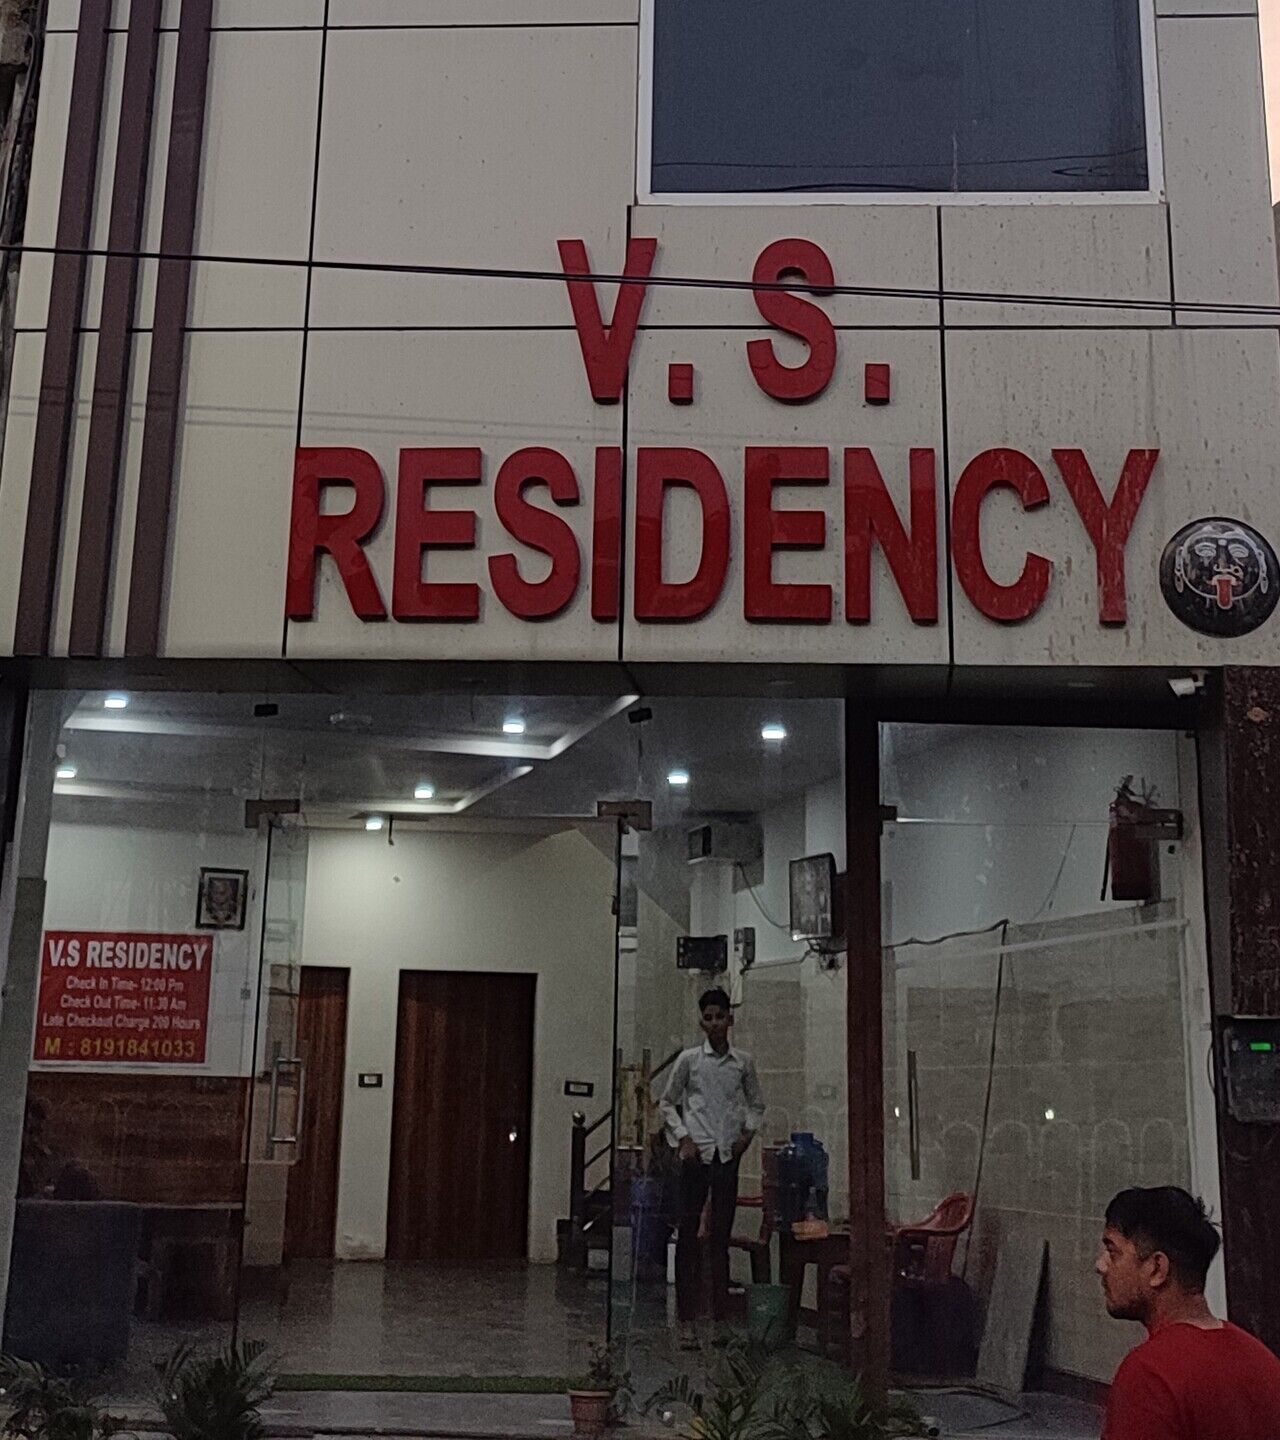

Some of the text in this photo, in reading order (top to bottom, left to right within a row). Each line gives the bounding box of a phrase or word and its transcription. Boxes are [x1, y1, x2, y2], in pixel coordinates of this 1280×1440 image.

[285, 445, 1160, 627] RESIDENCY
[47, 939, 208, 971] V.S RESIDENCY
[66, 975, 96, 991] Check
[60, 994, 91, 1009] Check
[44, 1036, 62, 1056] M
